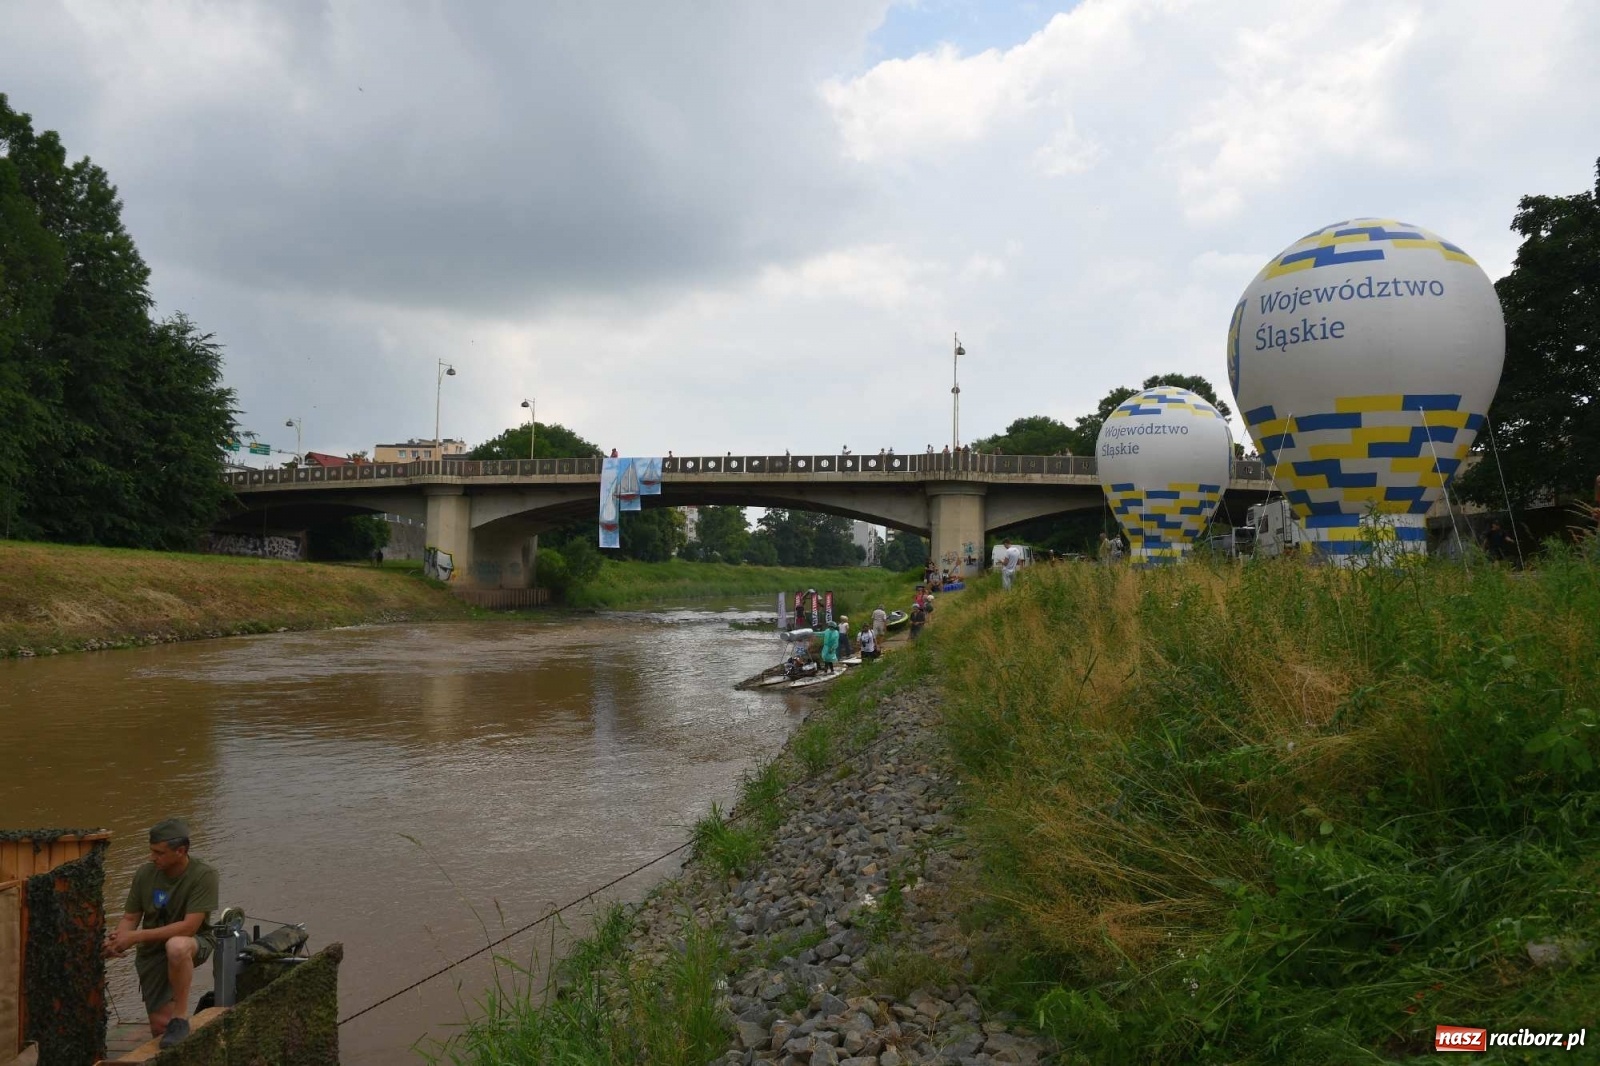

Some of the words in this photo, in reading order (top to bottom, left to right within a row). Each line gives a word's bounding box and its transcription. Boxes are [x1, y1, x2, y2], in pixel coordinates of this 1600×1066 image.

[1259, 276, 1445, 315] Województwo
[1255, 317, 1345, 352] Śląskie
[1104, 422, 1189, 439] Województwo
[1101, 442, 1140, 459] Śląskie
